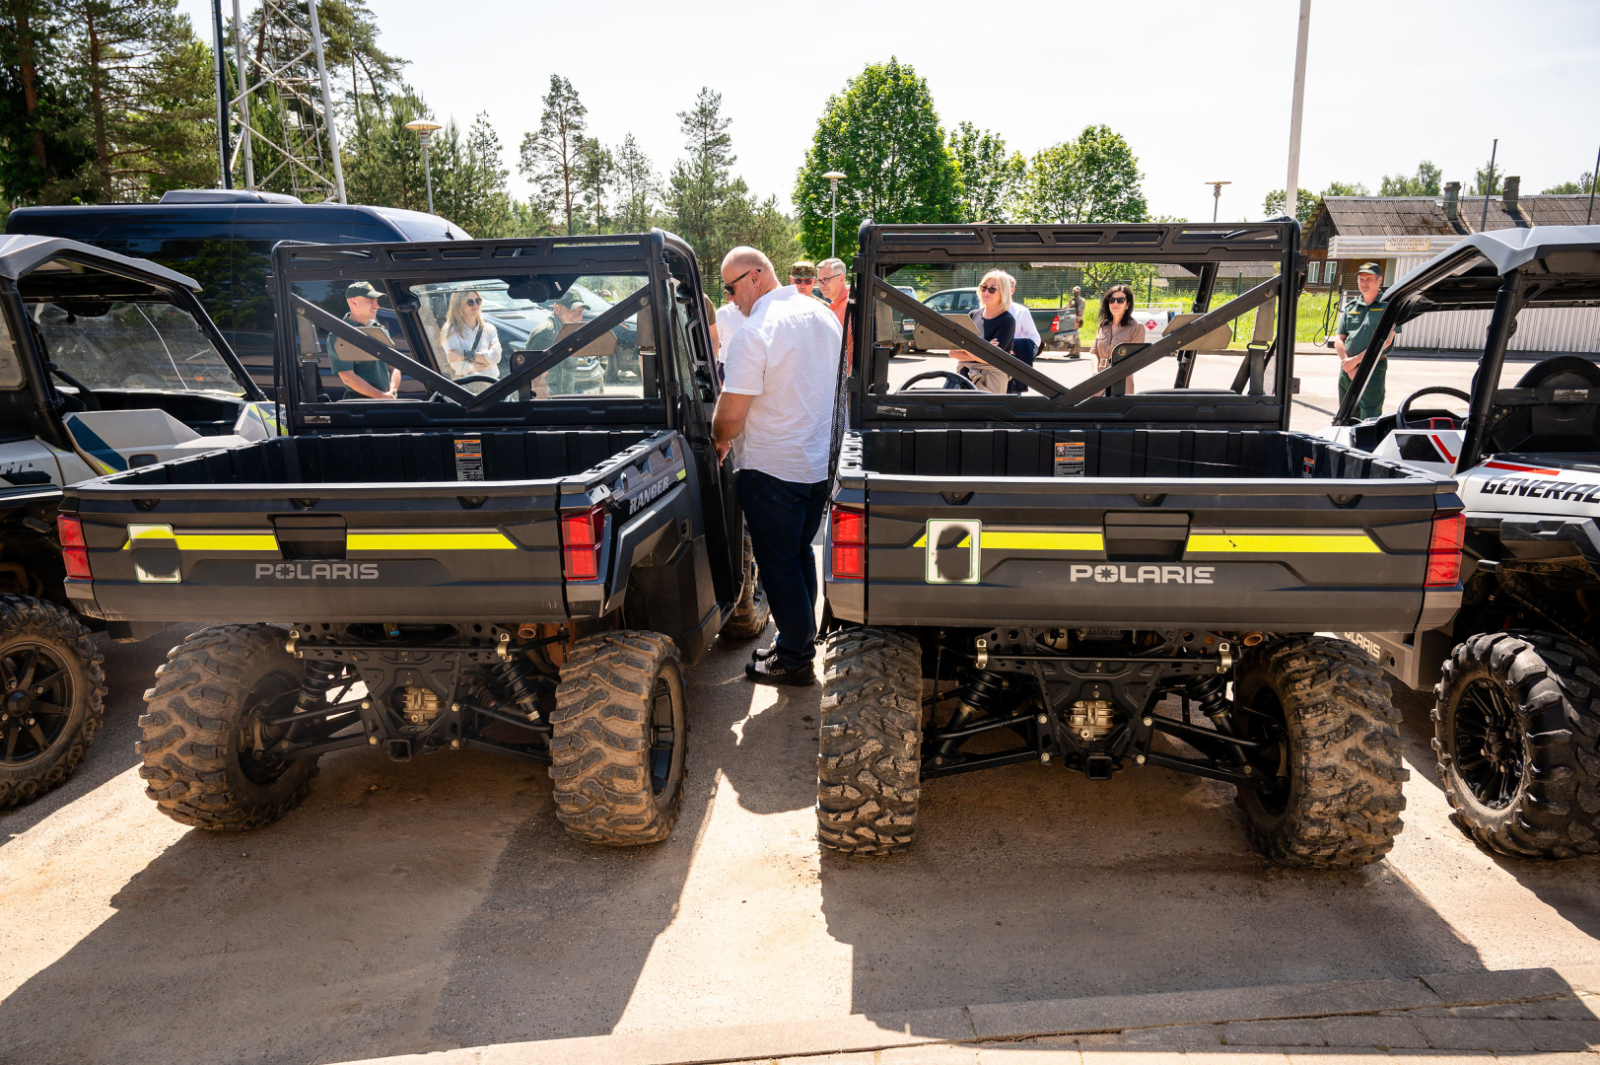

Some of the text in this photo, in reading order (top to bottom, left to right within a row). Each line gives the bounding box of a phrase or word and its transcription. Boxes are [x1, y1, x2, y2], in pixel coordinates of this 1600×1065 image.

[629, 475, 669, 515] RANGER
[1479, 476, 1600, 504] GENERAL
[255, 562, 379, 581] POLARIS
[1070, 564, 1215, 585] POLARIS
[1344, 631, 1381, 659] OLARIS
[767, 668, 786, 677] HOKA
